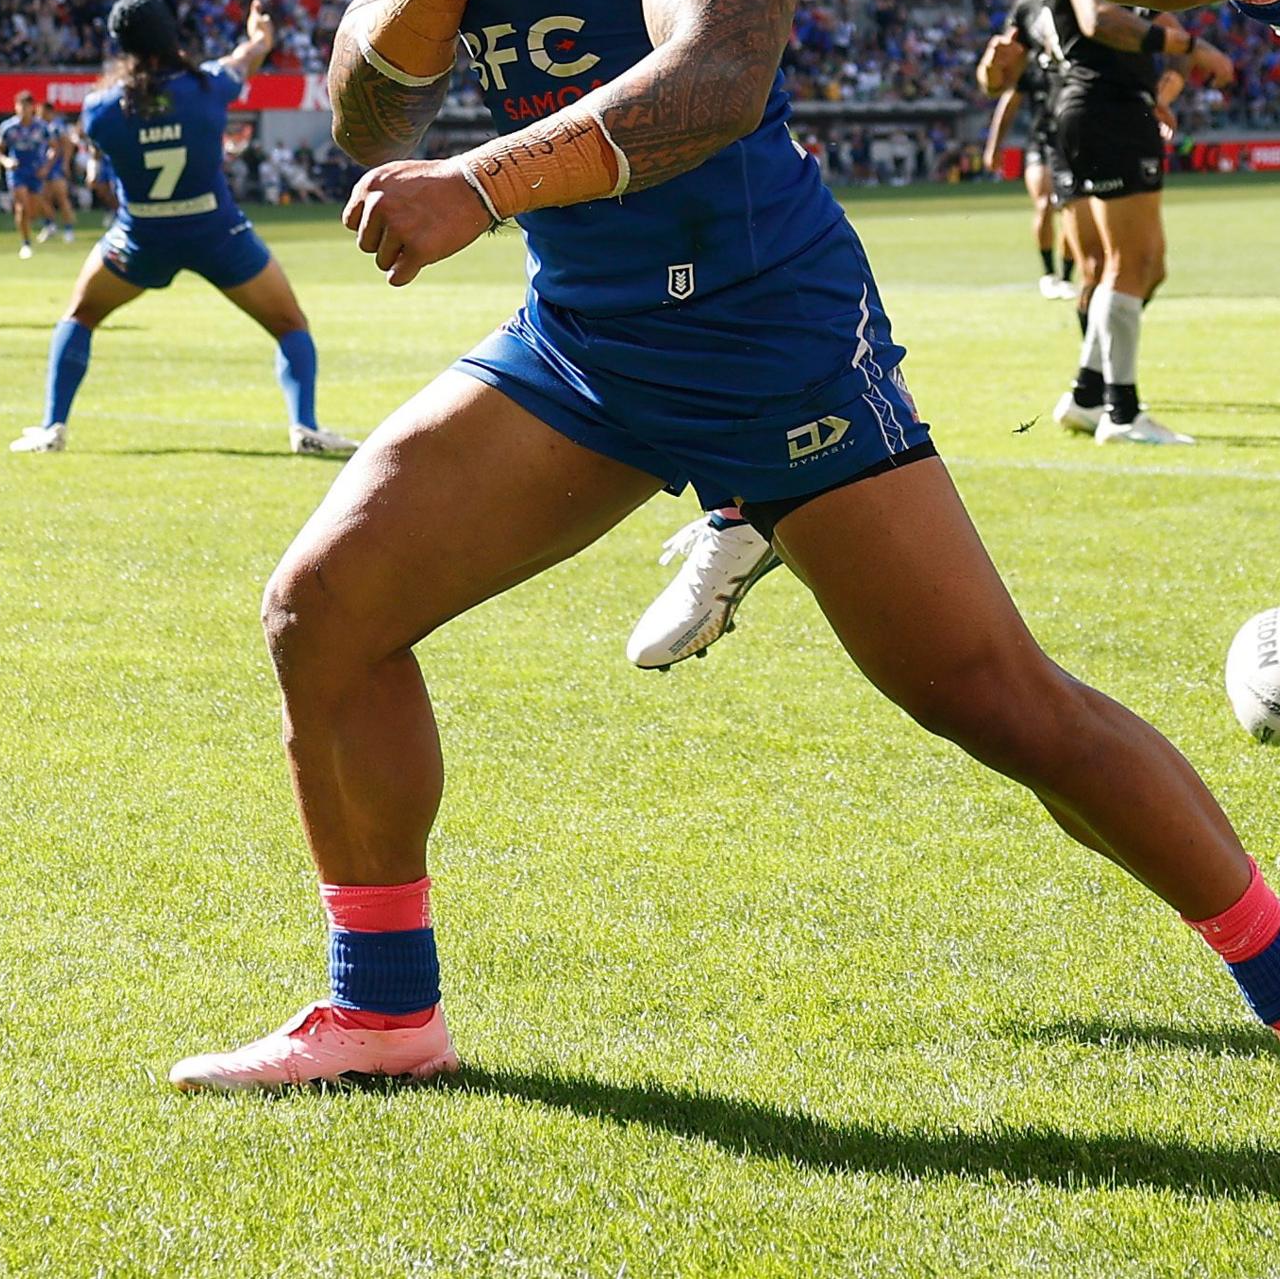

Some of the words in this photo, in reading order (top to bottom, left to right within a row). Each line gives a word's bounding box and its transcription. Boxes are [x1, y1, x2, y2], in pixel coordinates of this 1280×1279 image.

[503, 79, 604, 121] SAMO
[139, 124, 181, 144] LUAI
[143, 147, 187, 200] 7
[789, 439, 856, 469] DYNASTY
